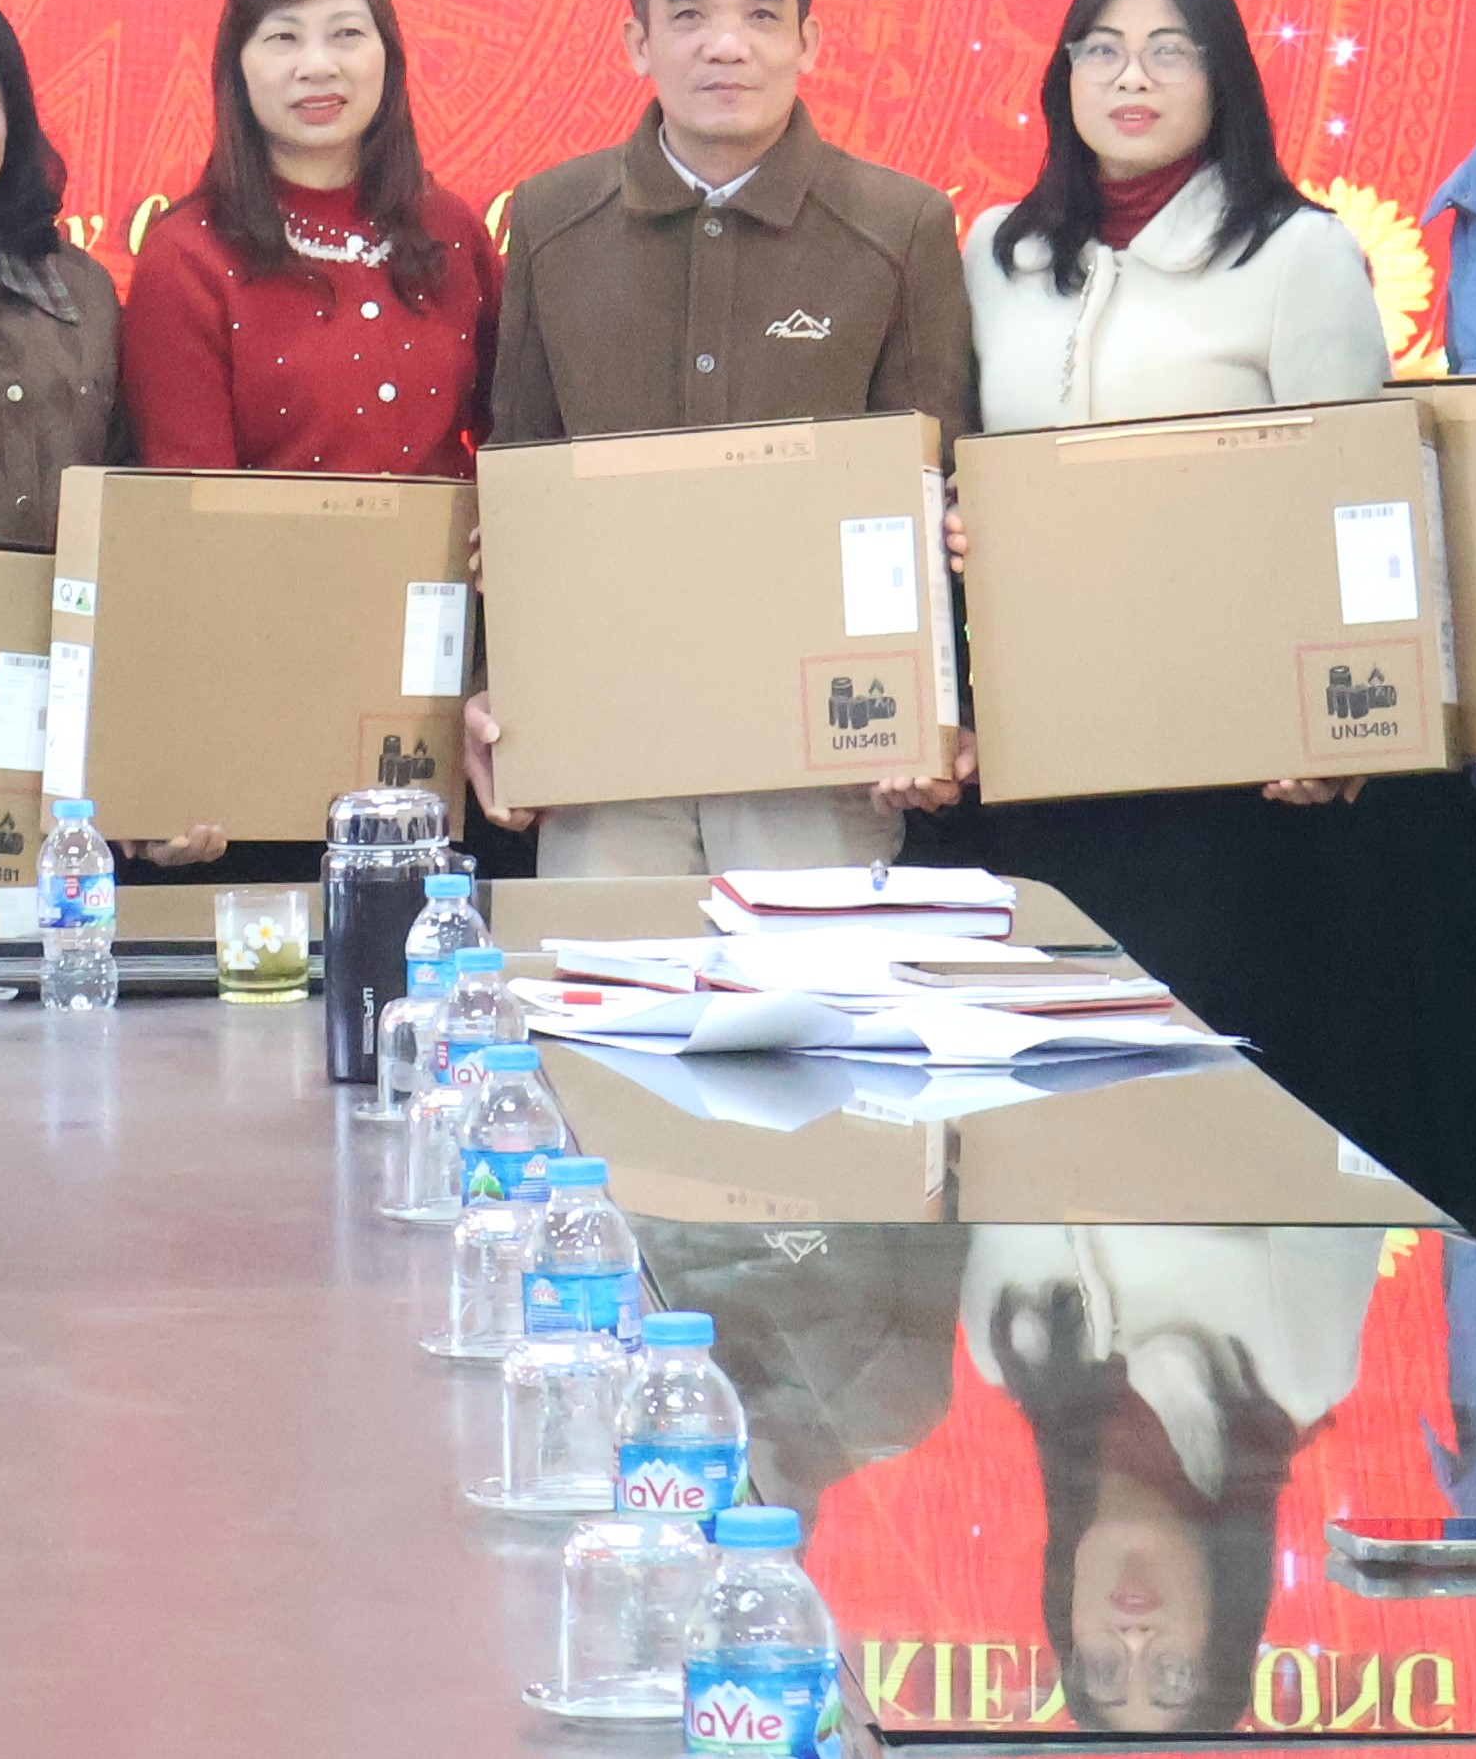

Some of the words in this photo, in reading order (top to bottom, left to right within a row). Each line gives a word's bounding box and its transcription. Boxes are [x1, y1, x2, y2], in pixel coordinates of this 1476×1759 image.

[831, 732, 898, 751] UN3481
[1330, 721, 1399, 741] UN3481
[83, 887, 115, 908] laV
[451, 1062, 488, 1084] laV
[689, 1700, 784, 1741] laVie
